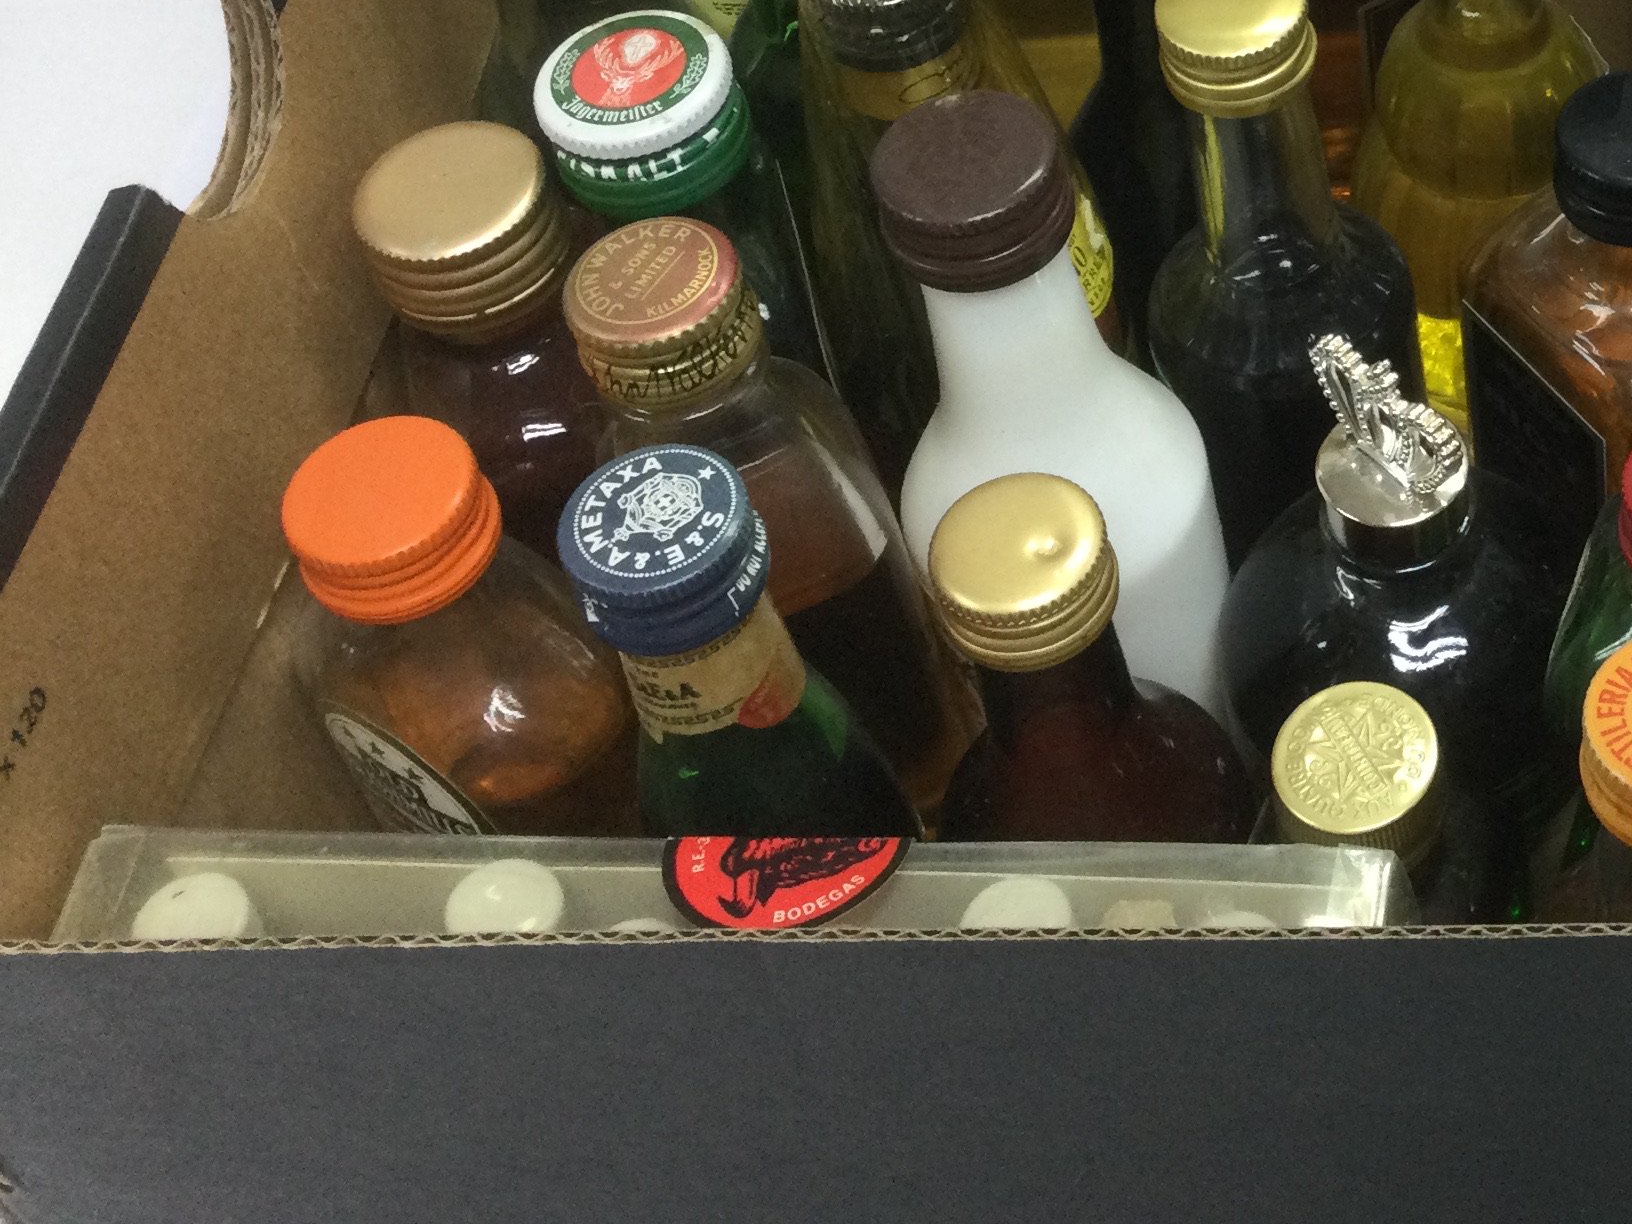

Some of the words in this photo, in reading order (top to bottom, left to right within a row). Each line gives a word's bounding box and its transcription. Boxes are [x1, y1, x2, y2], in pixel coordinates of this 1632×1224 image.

[589, 223, 693, 269] WALKER
[622, 241, 657, 277] SONS
[581, 273, 625, 318] JOHN
[624, 245, 677, 300] LIMITED
[645, 248, 715, 319] KILMARNOCK
[771, 873, 867, 925] BODEGAS
